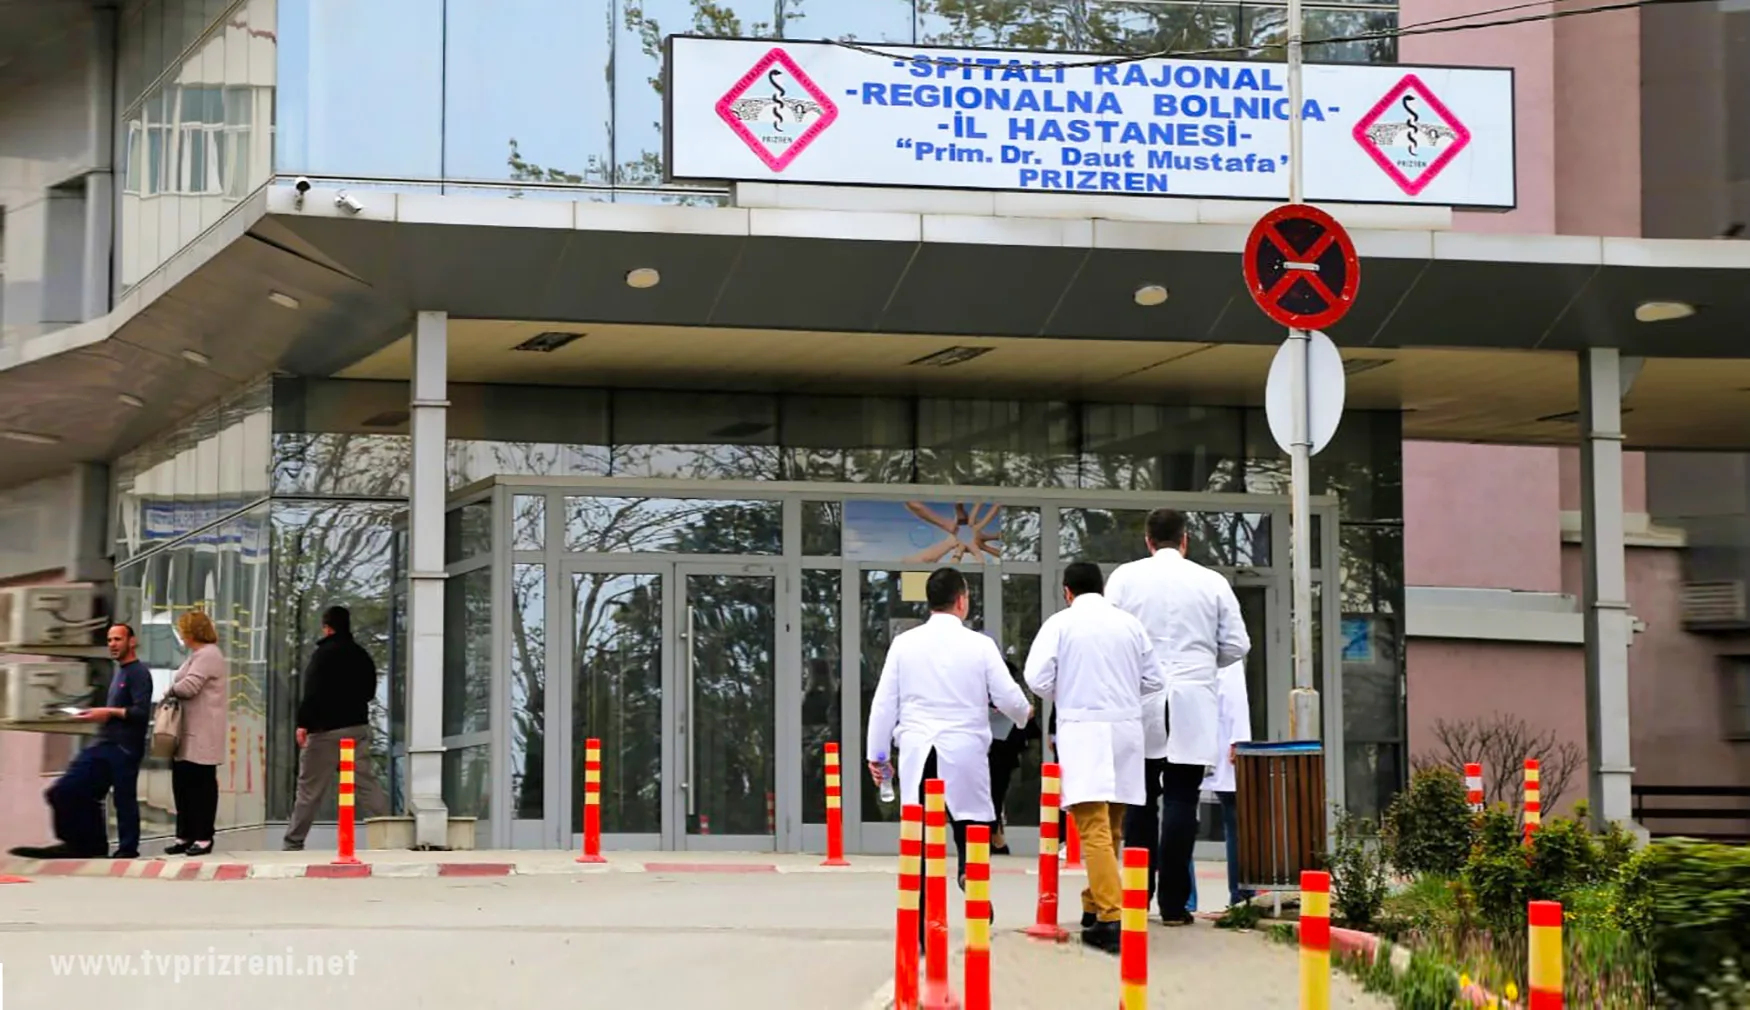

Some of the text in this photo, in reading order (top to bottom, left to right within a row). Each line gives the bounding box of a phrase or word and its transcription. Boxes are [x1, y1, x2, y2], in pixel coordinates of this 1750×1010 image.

[893, 54, 1065, 84] -SPITALI
[846, 82, 1123, 114] -REGIONALNA
[1153, 93, 1340, 121] BOLNICA-
[1001, 145, 1042, 164] Dr.
[1062, 147, 1134, 168] Daut
[1019, 168, 1168, 191] PRIZREN
